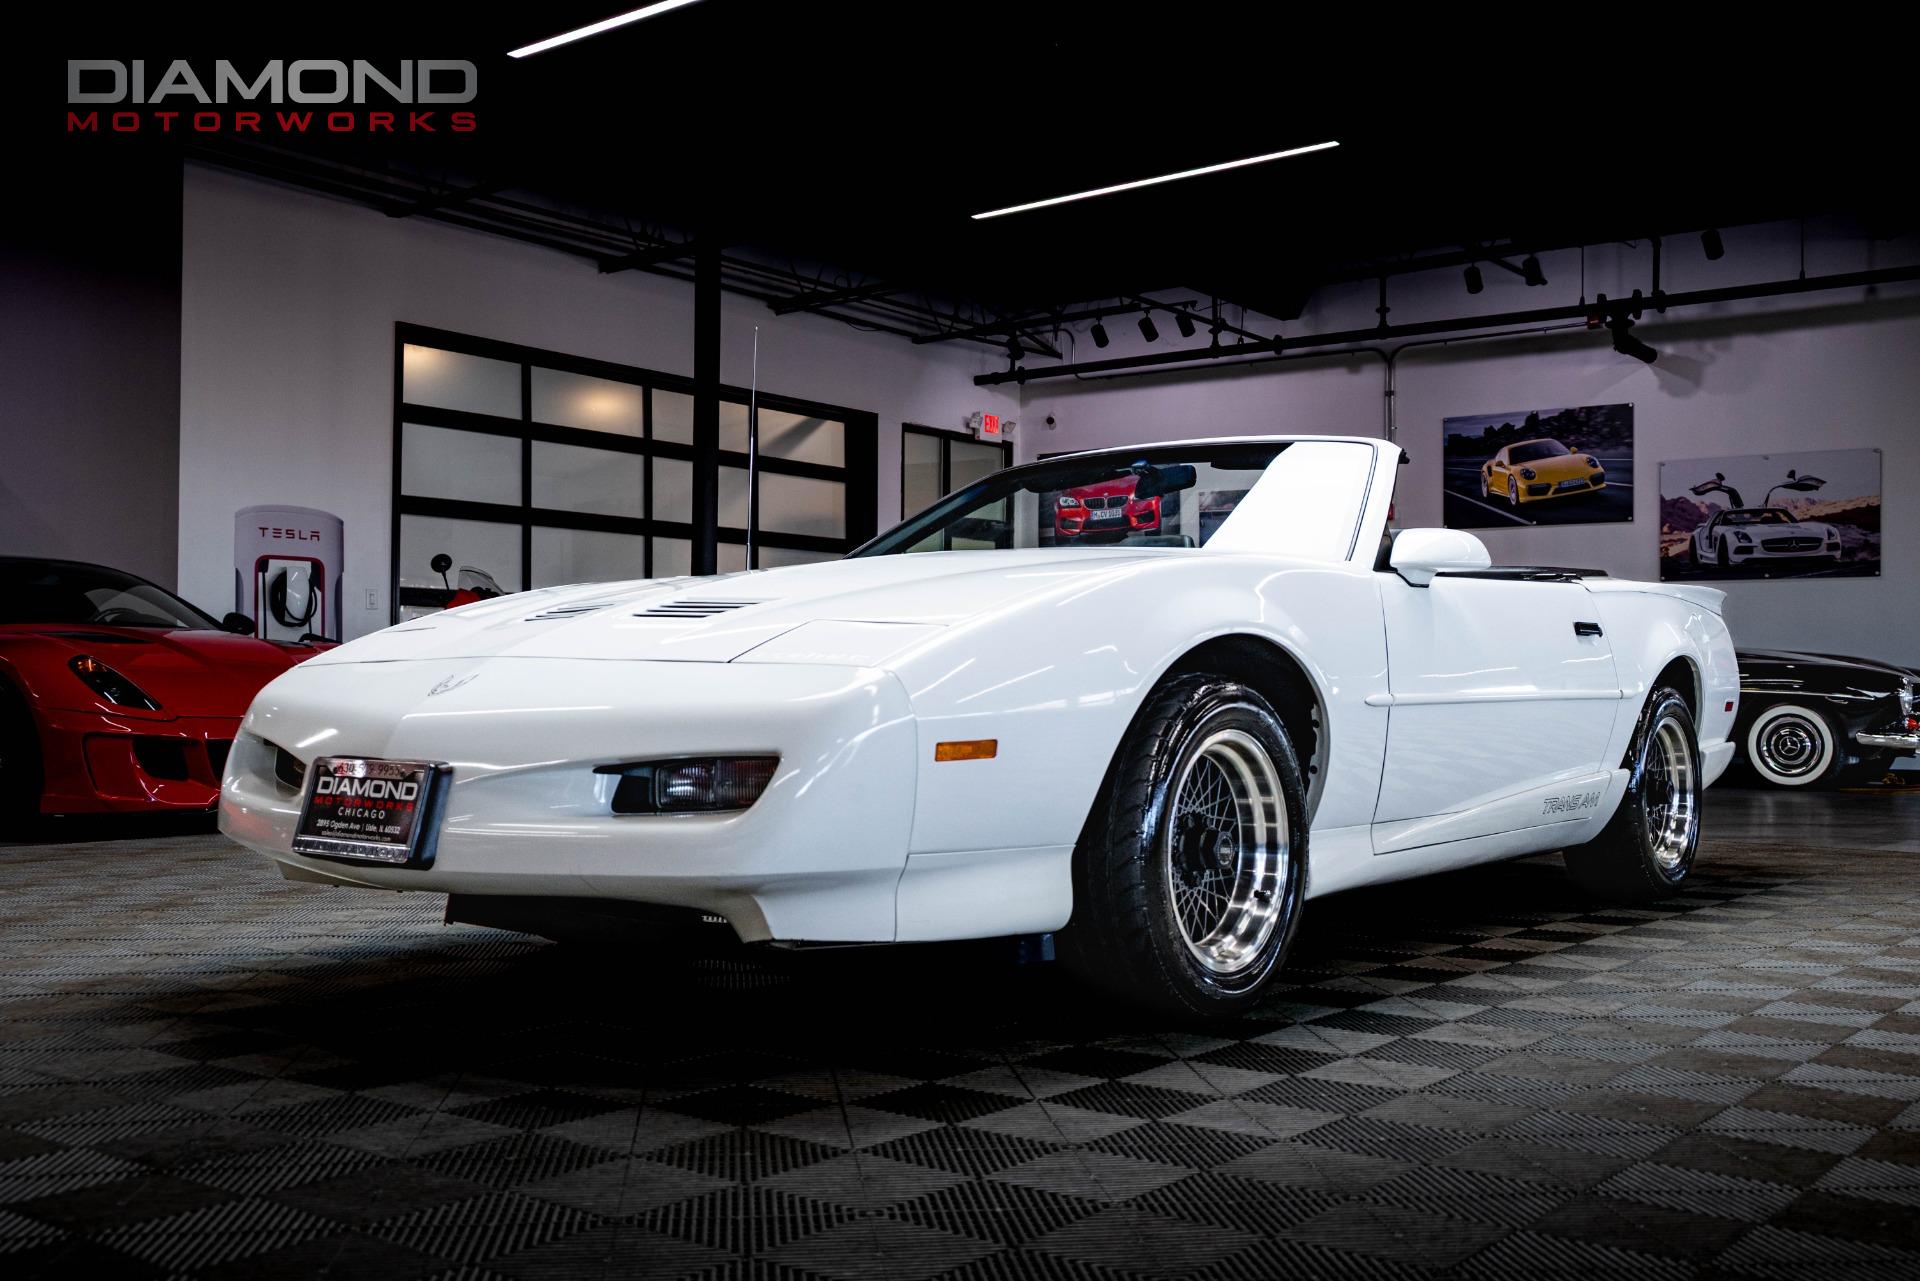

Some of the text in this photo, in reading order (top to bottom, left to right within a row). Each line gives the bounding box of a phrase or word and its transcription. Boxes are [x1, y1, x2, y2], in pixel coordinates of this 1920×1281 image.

[984, 415, 999, 433] EXIT
[258, 527, 321, 542] TESLA
[316, 776, 418, 801] DIAMOND
[313, 796, 415, 812] MOTORWORKS
[1542, 791, 1601, 815] TRANS AM
[337, 806, 386, 820] CHICAGO
[330, 819, 349, 830] Ogden
[348, 822, 361, 831] Ave
